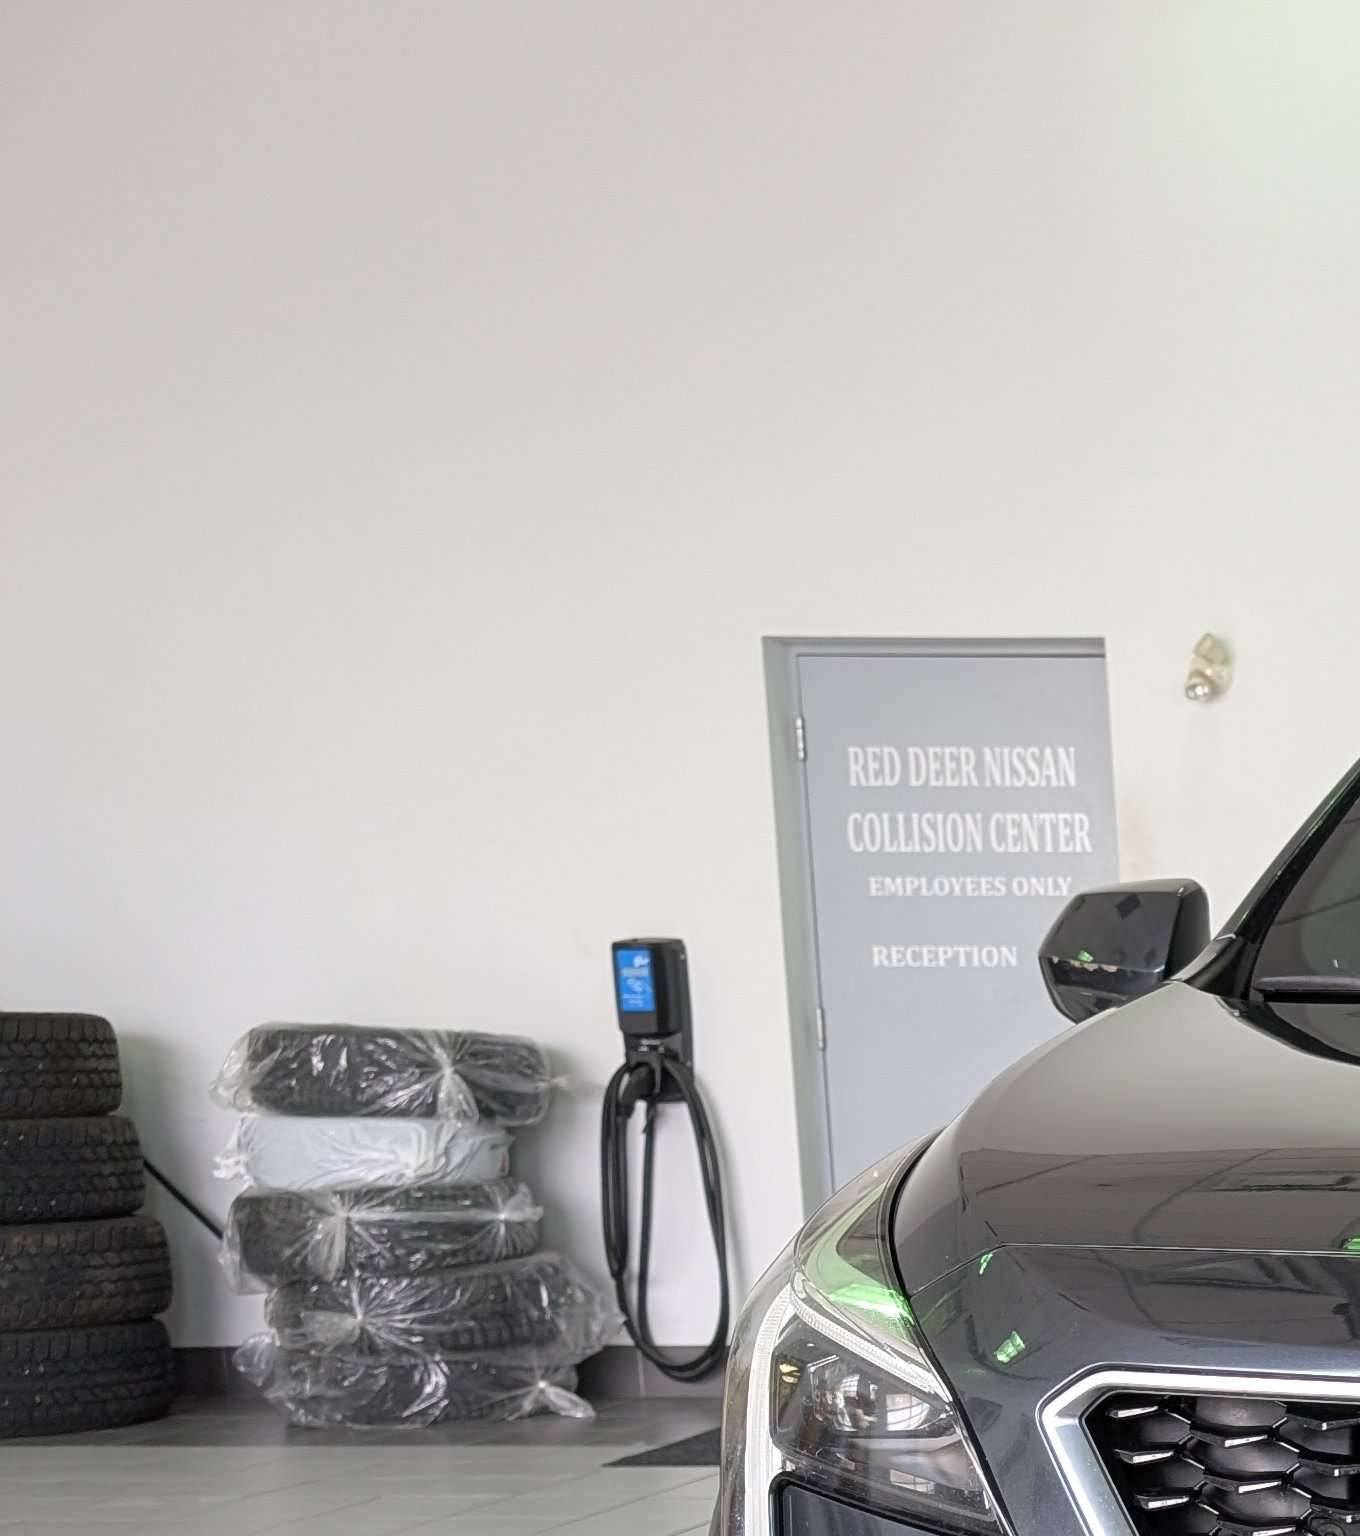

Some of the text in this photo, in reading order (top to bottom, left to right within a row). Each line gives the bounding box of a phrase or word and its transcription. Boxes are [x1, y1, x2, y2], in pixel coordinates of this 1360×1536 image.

[848, 745, 1077, 788] RED DEER NISSAN
[847, 812, 1093, 853] COLLISION CENTER
[868, 875, 1073, 897] EMPLOYEES ONLY
[871, 945, 1018, 968] RECEPTION
